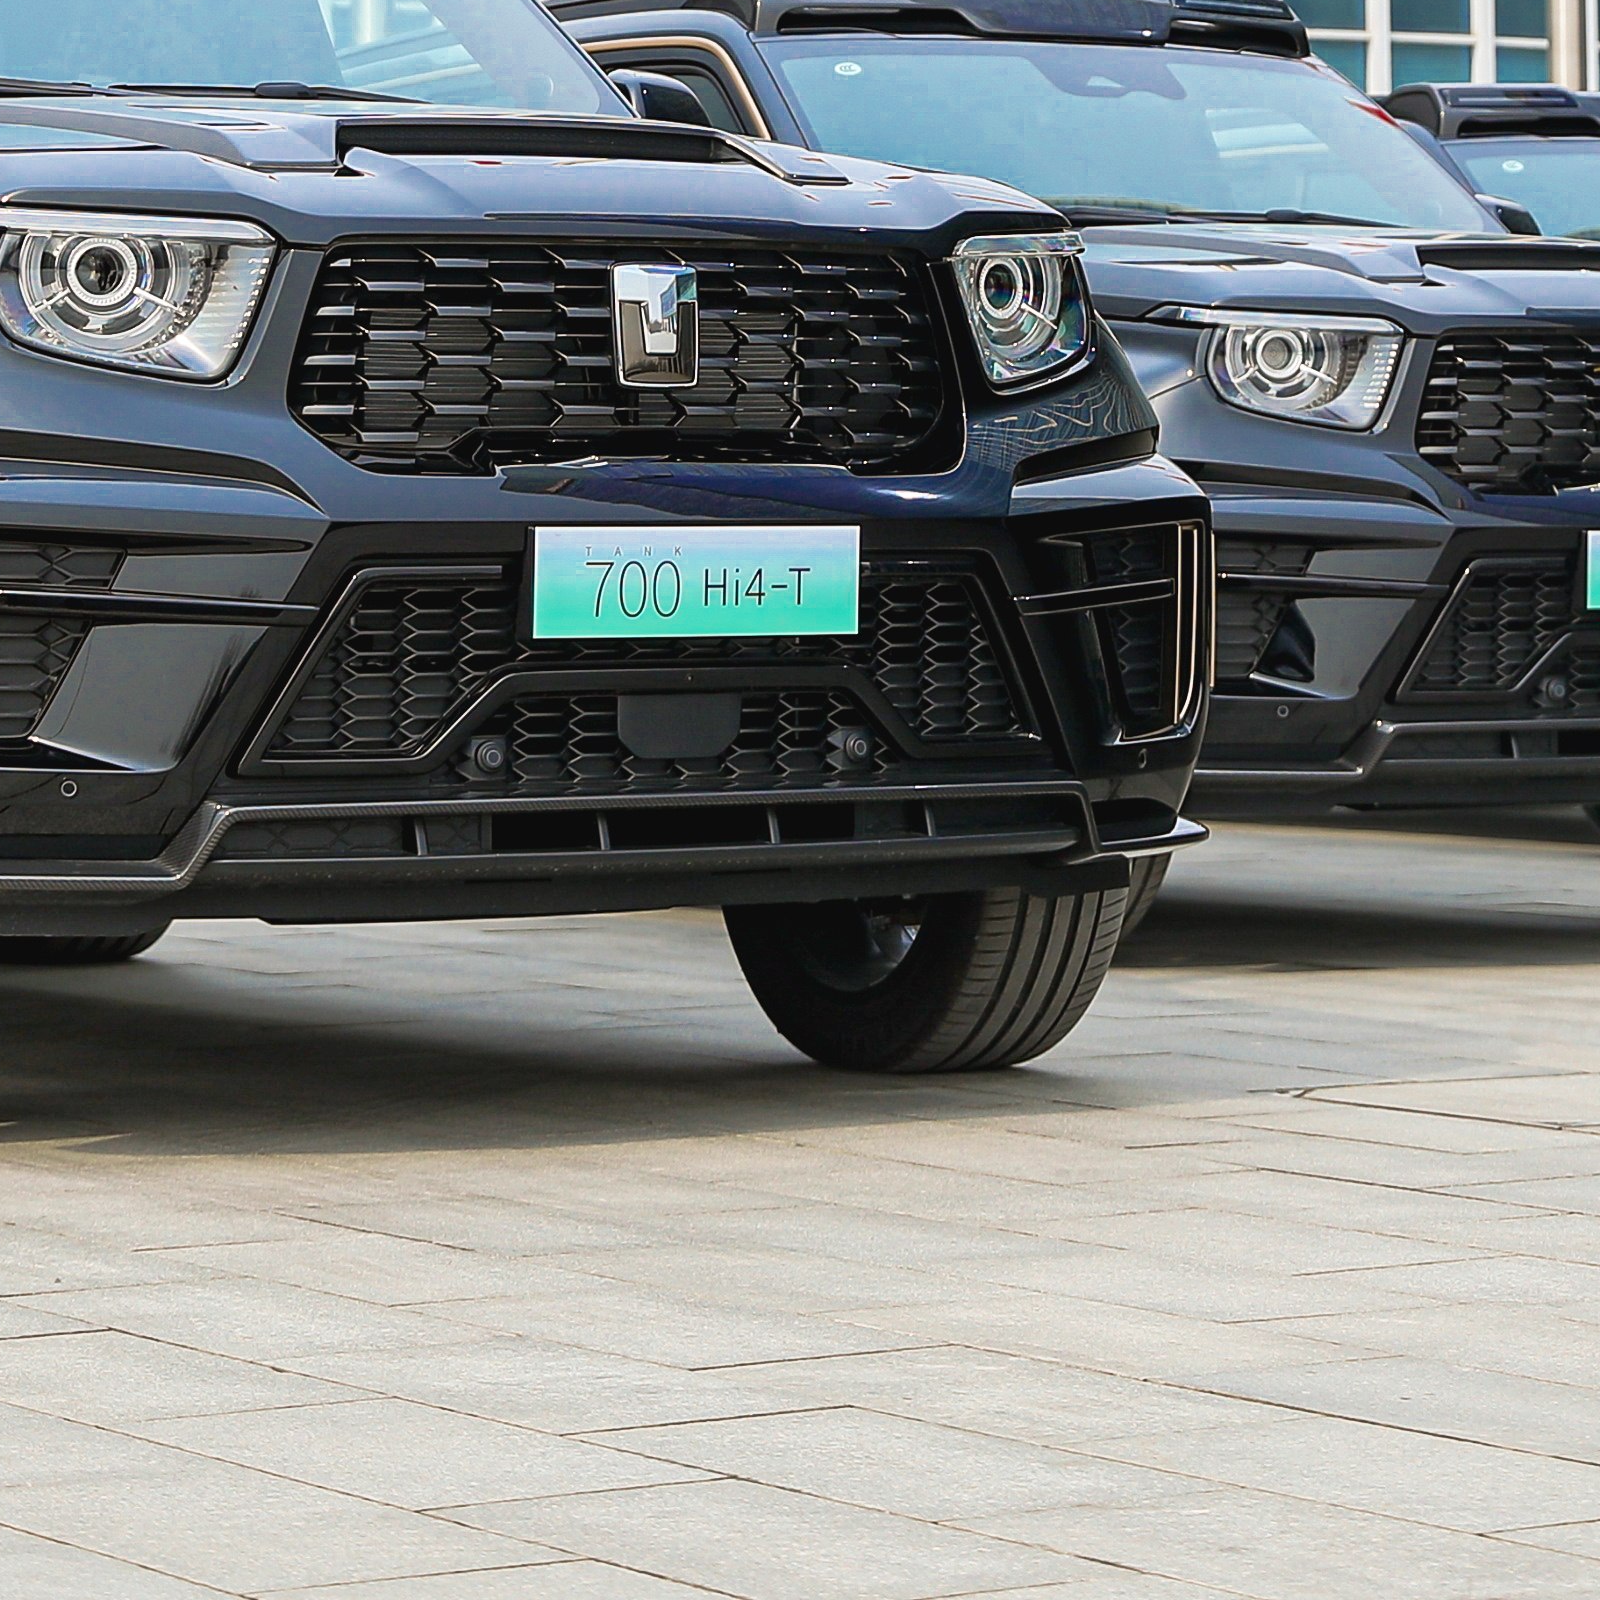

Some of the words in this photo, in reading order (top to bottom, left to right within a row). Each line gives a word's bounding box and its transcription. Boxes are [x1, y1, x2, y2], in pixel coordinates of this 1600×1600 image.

[585, 546, 682, 557] TANK
[586, 560, 681, 618] 700
[703, 568, 811, 607] Hi4-T
